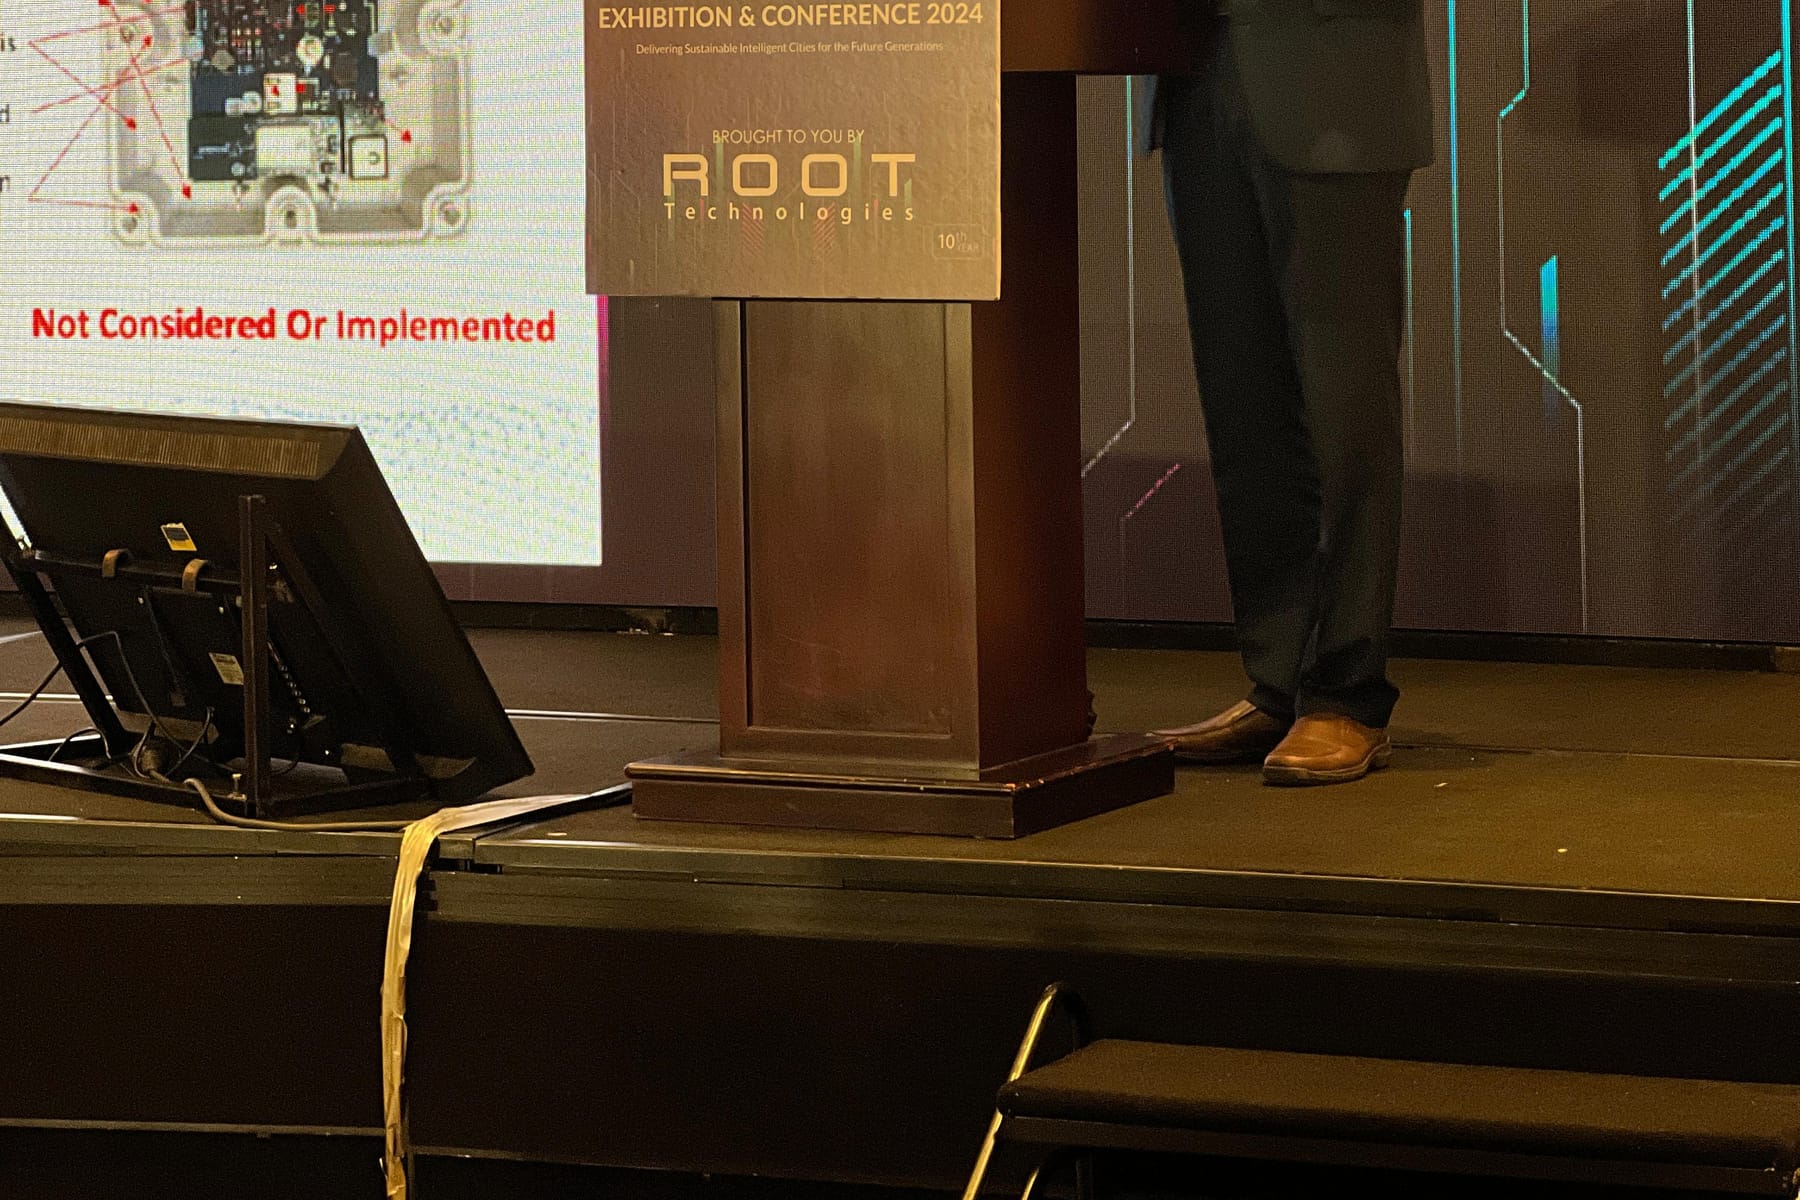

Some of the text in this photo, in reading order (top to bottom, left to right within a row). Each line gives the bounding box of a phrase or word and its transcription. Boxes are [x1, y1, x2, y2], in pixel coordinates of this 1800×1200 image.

[599, 2, 984, 29] EXHIBITION & CONFERENCE 2024
[636, 40, 945, 56] Delivering Sustainable Intelligent Cities for the Future Generations
[712, 129, 866, 145] BROUGHT TO YOU BY
[663, 153, 917, 197] ROOT
[664, 202, 915, 225] Technologies
[31, 307, 556, 347] Not Considered Or Implemented
